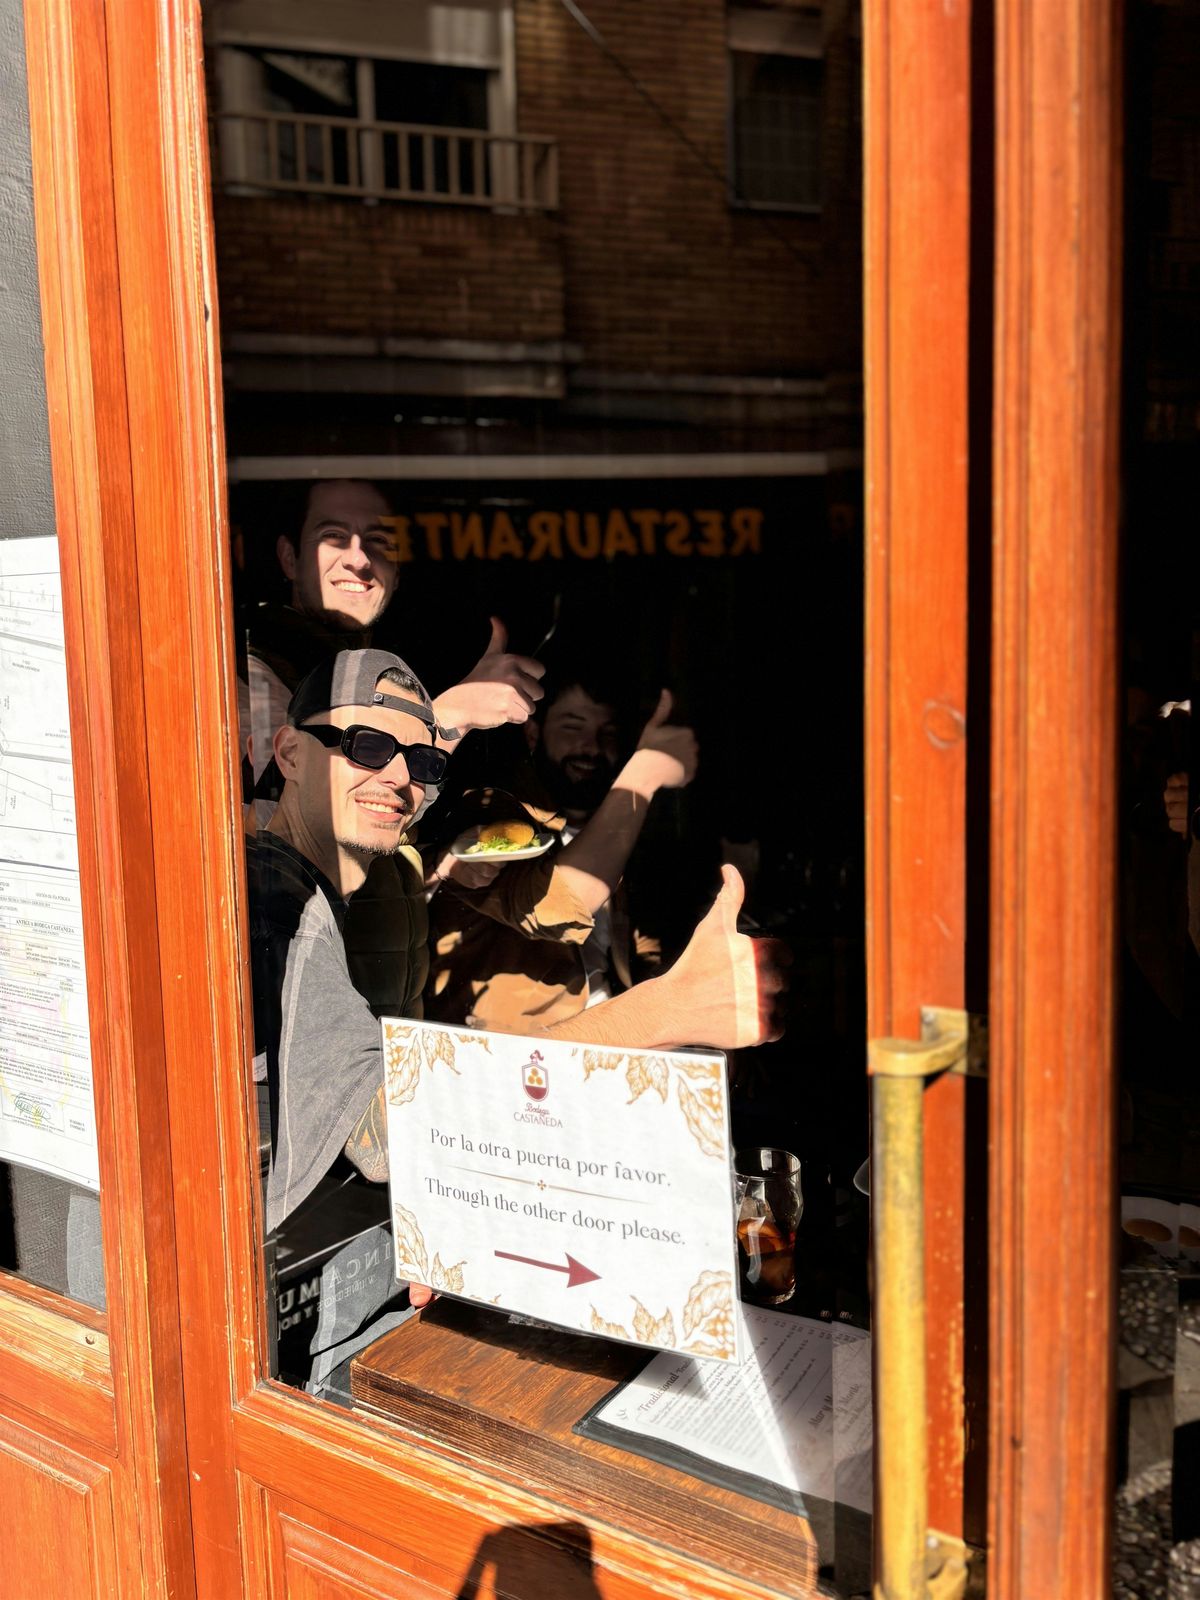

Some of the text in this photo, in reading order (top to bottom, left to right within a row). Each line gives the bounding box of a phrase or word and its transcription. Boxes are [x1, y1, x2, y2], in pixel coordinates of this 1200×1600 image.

[514, 1111, 563, 1128] CASTAÑEDA
[430, 1128, 672, 1187] Por la otra puerta por favor.
[425, 1177, 686, 1246] Through the other door please.
[638, 1370, 679, 1413] Tradicional
